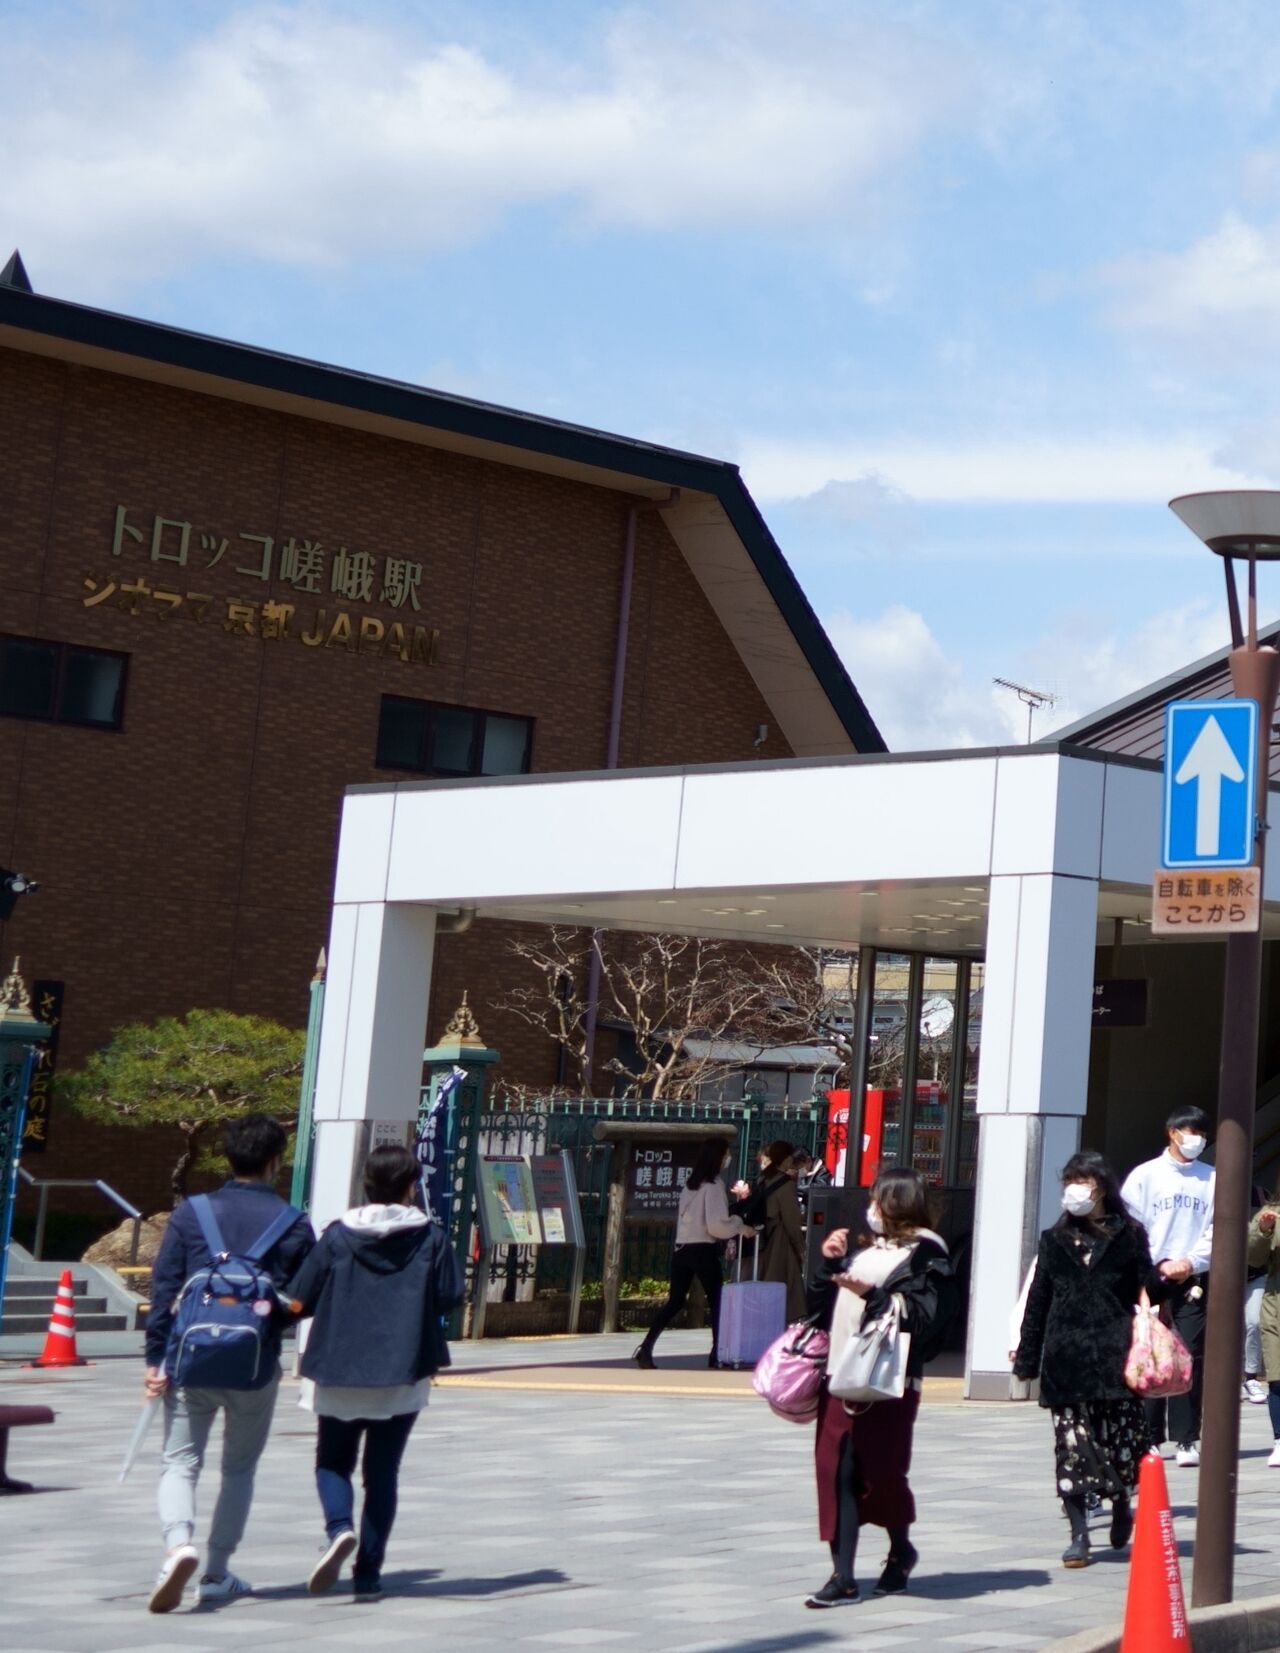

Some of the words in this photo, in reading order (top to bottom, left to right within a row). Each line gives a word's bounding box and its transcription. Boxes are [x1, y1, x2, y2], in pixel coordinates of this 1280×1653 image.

[112, 504, 423, 611] トロッコ嵯峨駅
[301, 609, 441, 665] JAPAN
[1159, 878, 1256, 898] 自転車を除く
[1166, 903, 1246, 924] ここから
[635, 1149, 673, 1163] トロッコ
[1153, 1194, 1209, 1216] MEMORY
